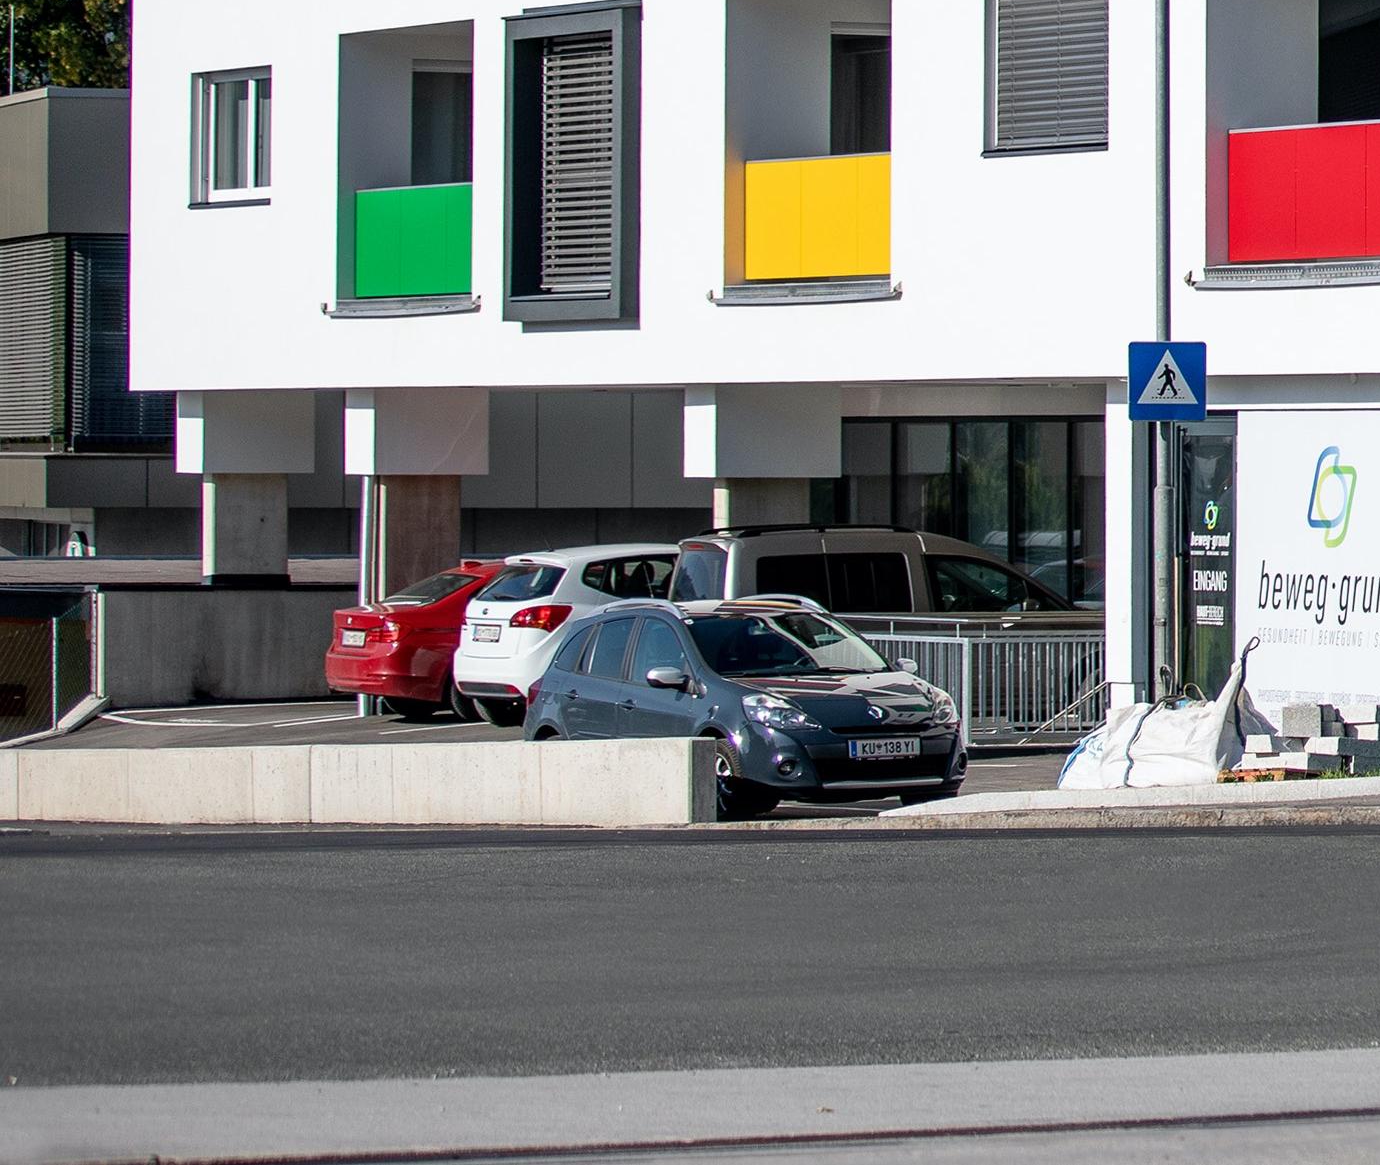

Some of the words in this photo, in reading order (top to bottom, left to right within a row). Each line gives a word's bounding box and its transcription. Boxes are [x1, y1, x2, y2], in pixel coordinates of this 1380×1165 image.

[1193, 570, 1228, 592] EINGANG
[1257, 627, 1308, 644] GESUNDHEIT
[1318, 630, 1363, 647] BEWEGUNG
[862, 742, 876, 755] KU
[883, 741, 902, 754] 138
